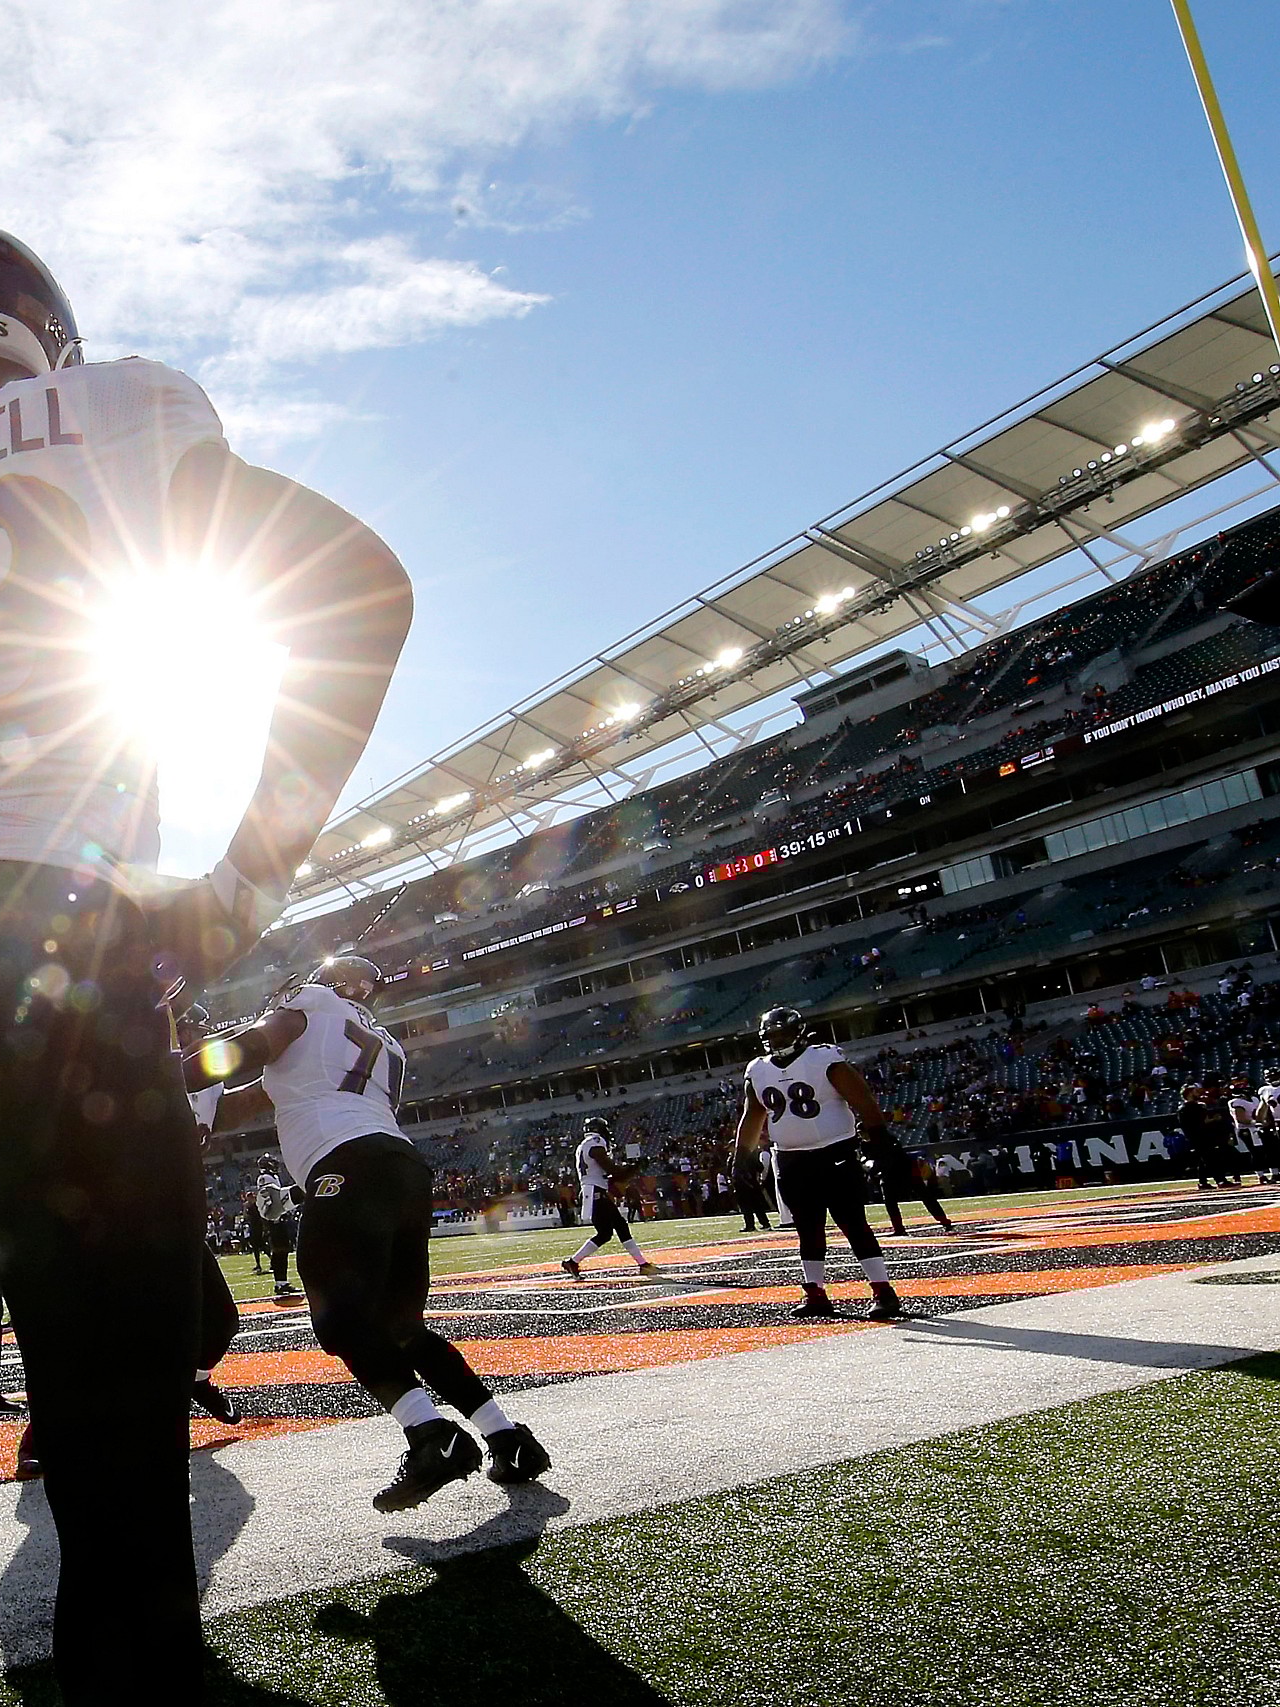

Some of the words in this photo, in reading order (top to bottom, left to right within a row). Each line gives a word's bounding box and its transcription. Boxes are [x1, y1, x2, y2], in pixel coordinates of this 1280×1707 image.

[1083, 732, 1092, 744] IF
[1092, 725, 1110, 740] YOU
[1110, 715, 1135, 734] DON'T
[1135, 704, 1162, 724] KNOW
[1162, 695, 1185, 713] WHO
[1184, 688, 1206, 704] DEY,
[1205, 674, 1239, 696] MAYBE
[1238, 665, 1260, 682] YOU
[779, 831, 826, 859] 39:15
[762, 1081, 821, 1124] 98
[314, 1173, 345, 1198] B
